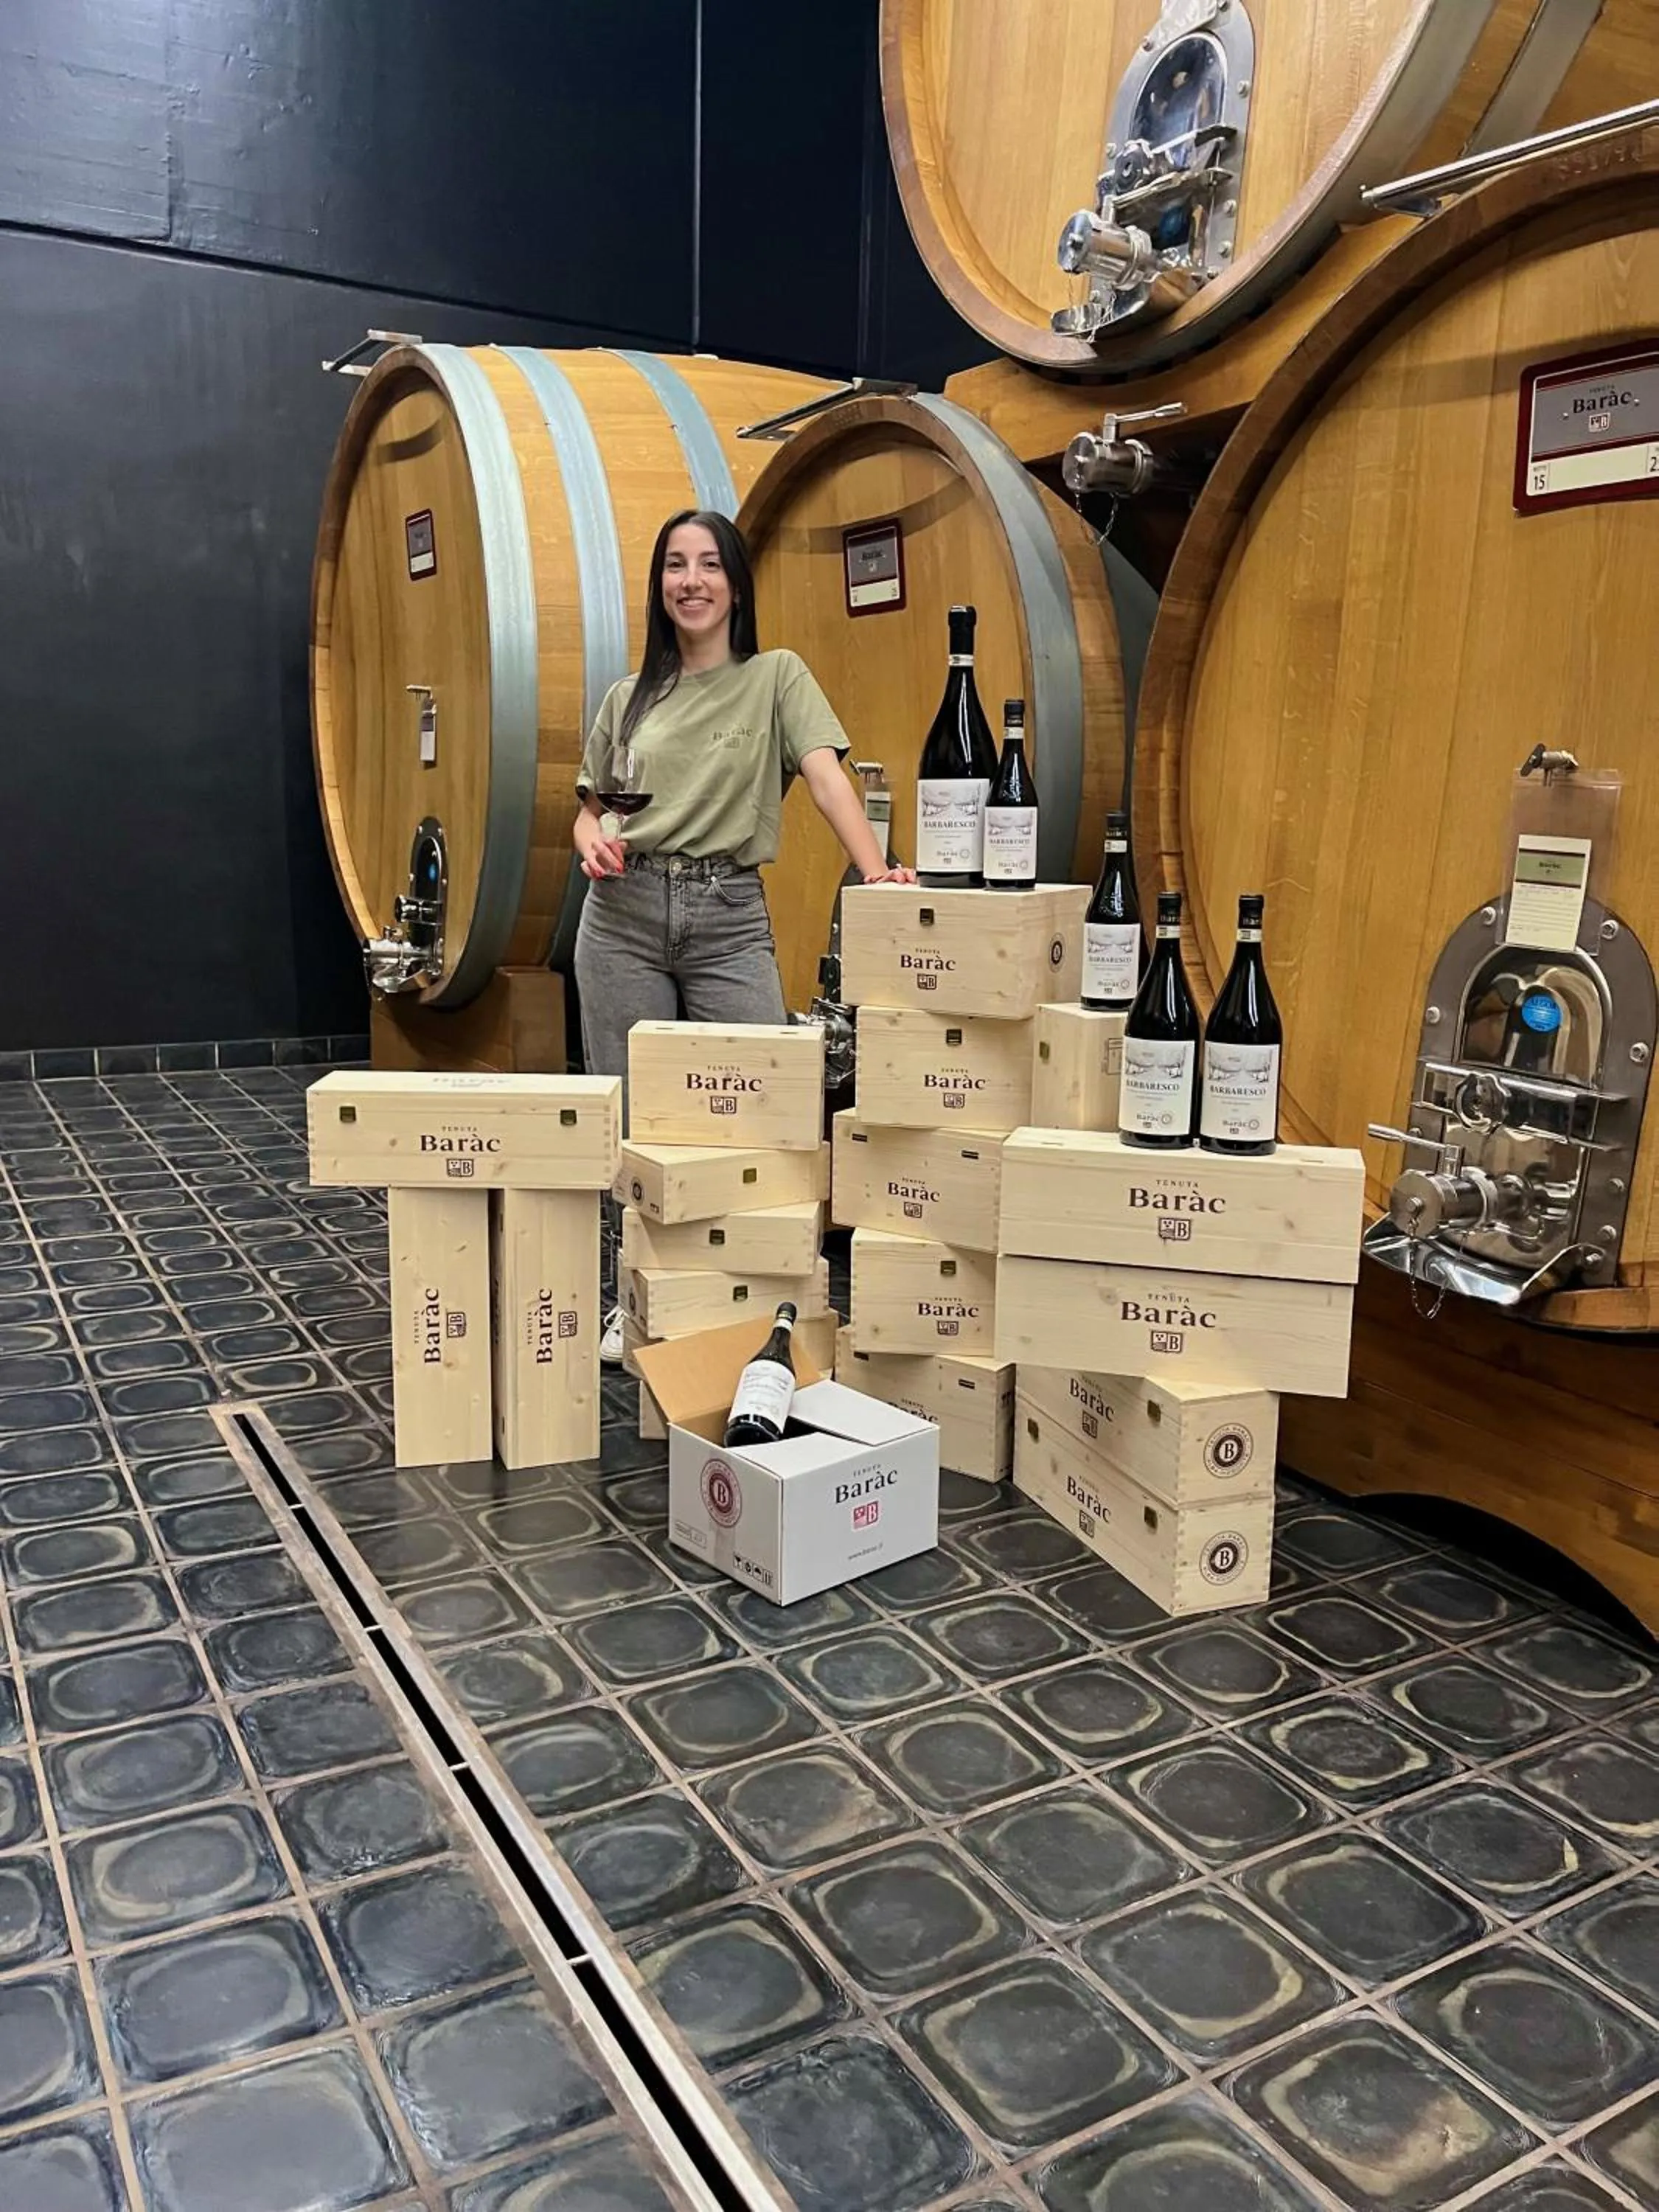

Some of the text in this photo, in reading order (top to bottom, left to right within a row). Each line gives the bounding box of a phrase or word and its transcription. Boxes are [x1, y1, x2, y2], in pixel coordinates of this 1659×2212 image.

[1573, 391, 1632, 414] Baràc
[1649, 456, 1659, 473] 2
[1534, 474, 1545, 490] 15
[924, 819, 975, 829] BARBARESCO
[900, 955, 956, 971] Baràc
[685, 1073, 762, 1092] Baràc
[924, 1074, 986, 1090] Baràc
[1126, 1079, 1180, 1091] BARBARESCO
[1210, 1085, 1266, 1096] BARBARESCO
[420, 1133, 501, 1152] Baràc
[888, 1182, 940, 1203] Baràc
[1155, 1180, 1199, 1188] TENUTA
[1128, 1188, 1226, 1214] Baràc
[1147, 1293, 1190, 1303] TENUTA
[918, 1302, 980, 1318] Baràc
[1121, 1301, 1217, 1328] Baràc
[421, 1288, 441, 1363] Baràc
[533, 1288, 552, 1363] Baràc
[1069, 1377, 1114, 1422] Baràc
[835, 1469, 898, 1504] Baràc
[1067, 1475, 1112, 1524] Baràc
